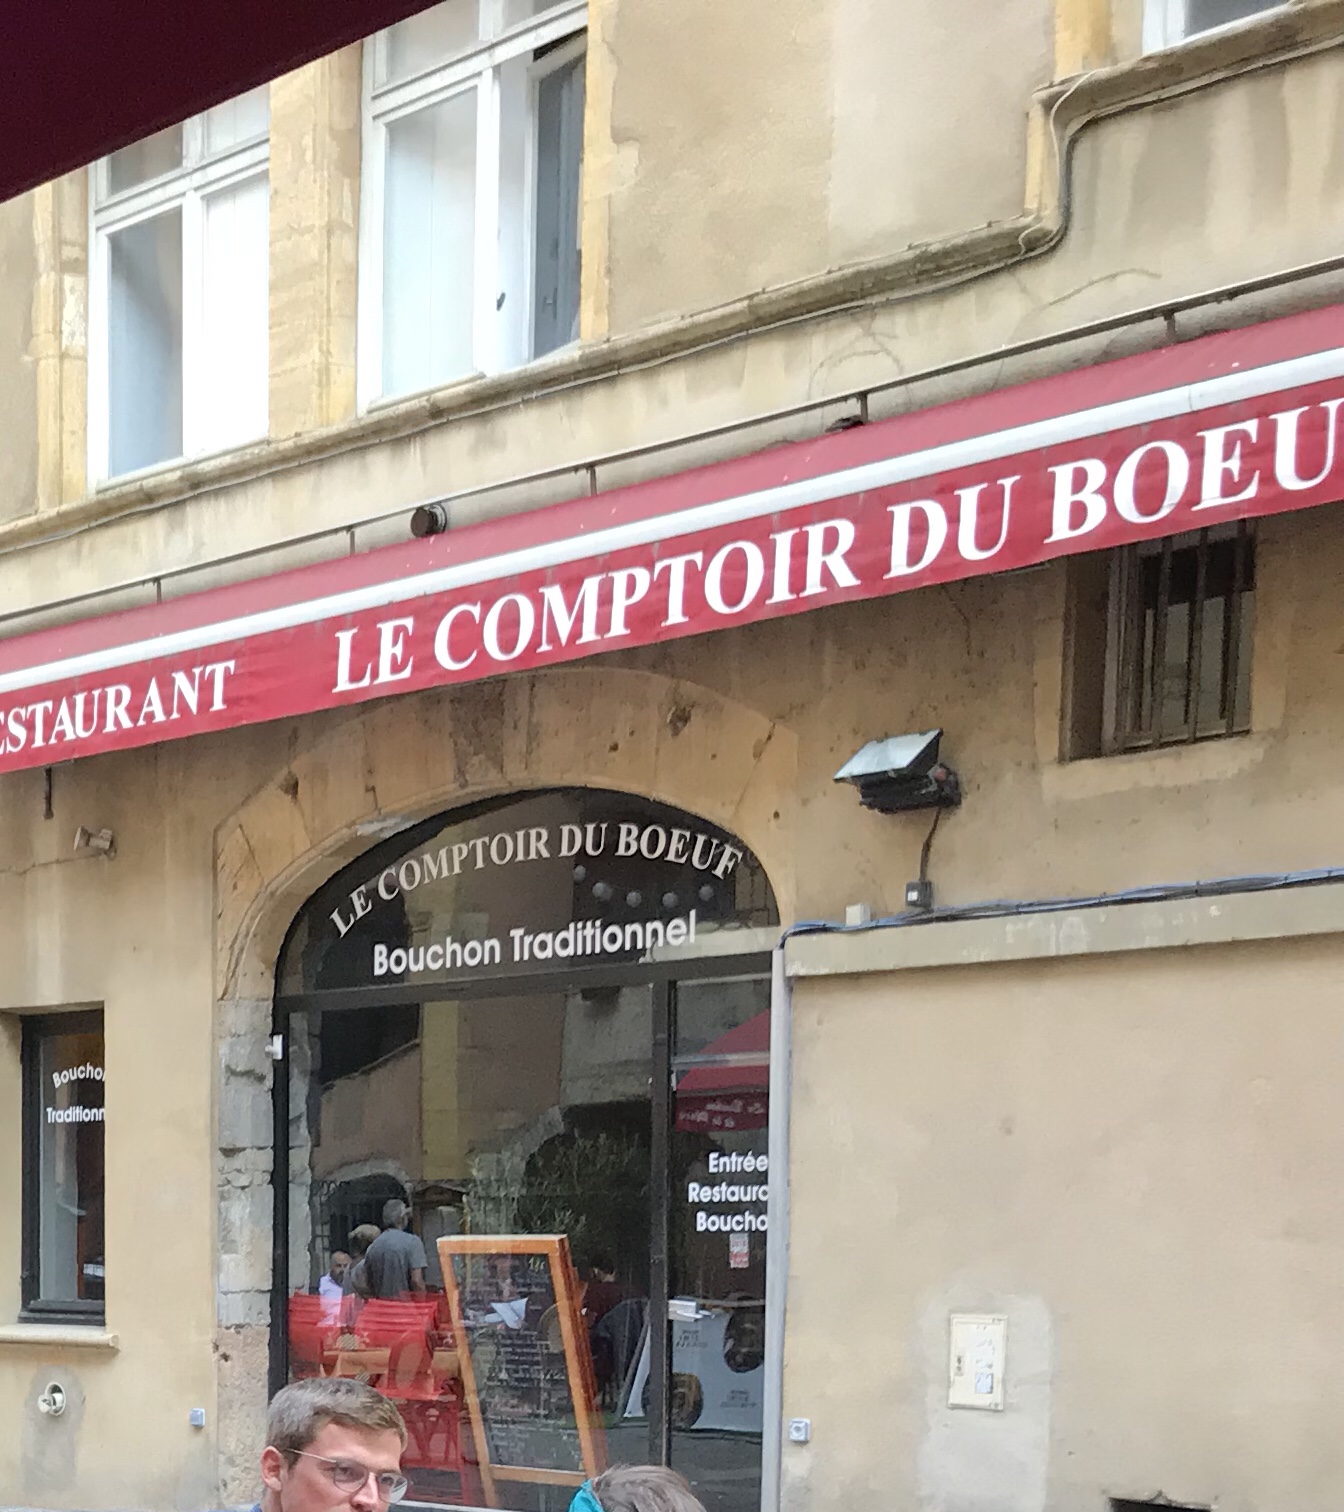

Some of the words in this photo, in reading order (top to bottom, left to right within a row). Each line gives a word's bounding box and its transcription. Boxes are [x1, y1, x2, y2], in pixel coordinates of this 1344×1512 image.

[332, 616, 415, 693] LE
[434, 518, 861, 671] COMPTOIR
[883, 475, 1022, 580] DU
[329, 884, 372, 938] LE
[377, 829, 550, 901] COMPTOIR
[558, 822, 609, 858] DU
[615, 823, 743, 880] BOEUF
[373, 935, 501, 976] Bouchon
[510, 909, 697, 962] Traditionnel
